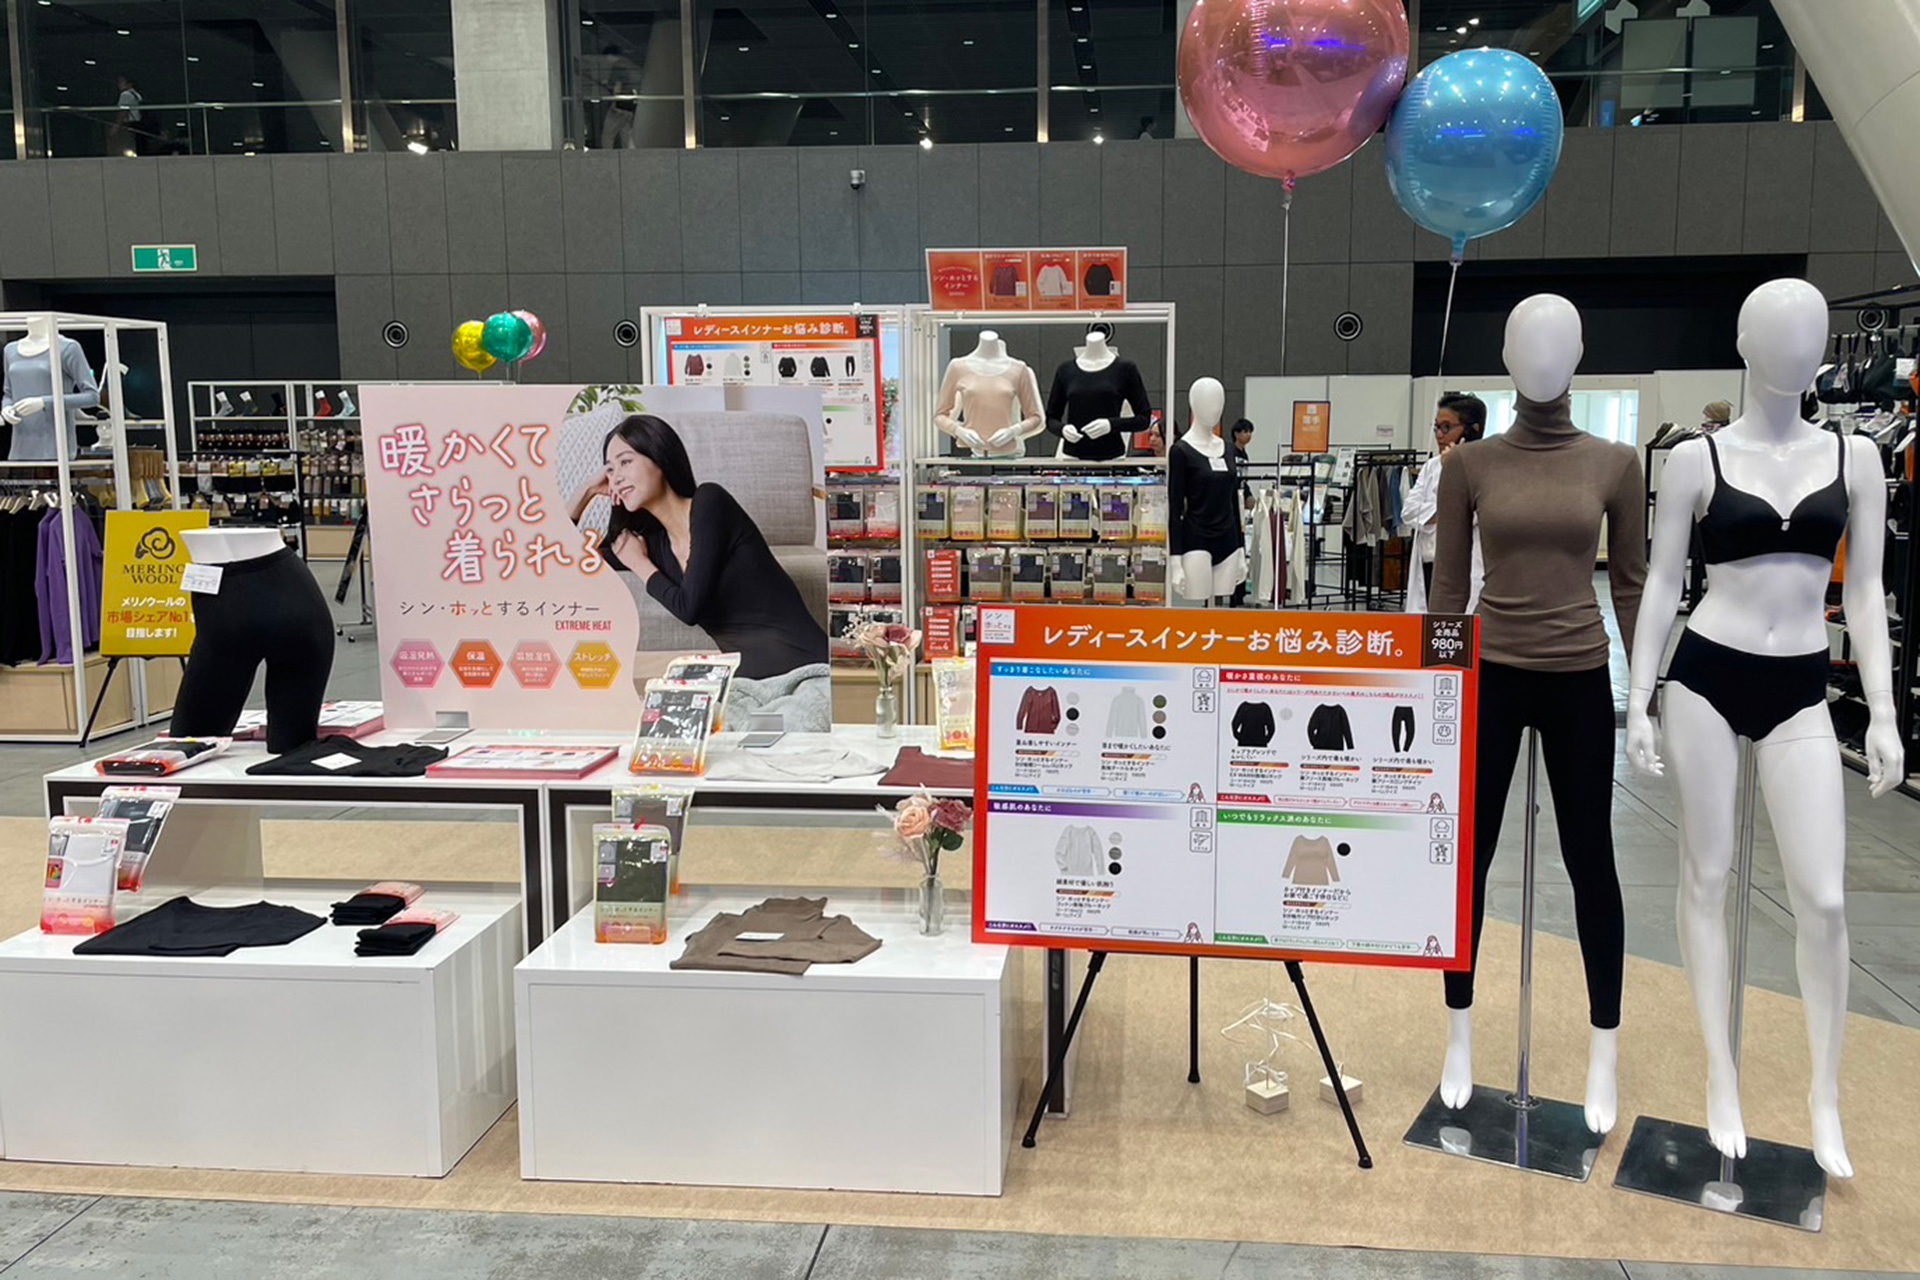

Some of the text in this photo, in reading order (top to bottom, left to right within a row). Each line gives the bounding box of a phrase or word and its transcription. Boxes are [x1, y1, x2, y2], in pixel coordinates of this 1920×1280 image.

[693, 322, 849, 336] レディースインナーお悩み診断。
[379, 424, 549, 476] 暖かくて
[409, 477, 546, 526] さらっと
[442, 530, 603, 583] 着られる
[131, 574, 178, 585] WOOL
[121, 597, 186, 607] メリノウールの
[555, 620, 612, 631] EXTREME HEAT
[1434, 628, 1460, 637] 全商品
[1044, 624, 1403, 657] レディースインナーお悩み診断。
[1431, 638, 1464, 650] 980円
[466, 651, 485, 660] 保温
[574, 652, 612, 661] ストレッチ
[1438, 650, 1456, 659] 以下
[1226, 672, 1301, 682] 暖かさ重視のあなたに
[993, 802, 1052, 812] 敏感肌のあなたに
[1222, 812, 1332, 824] いつでもリラックス派のあなたに
